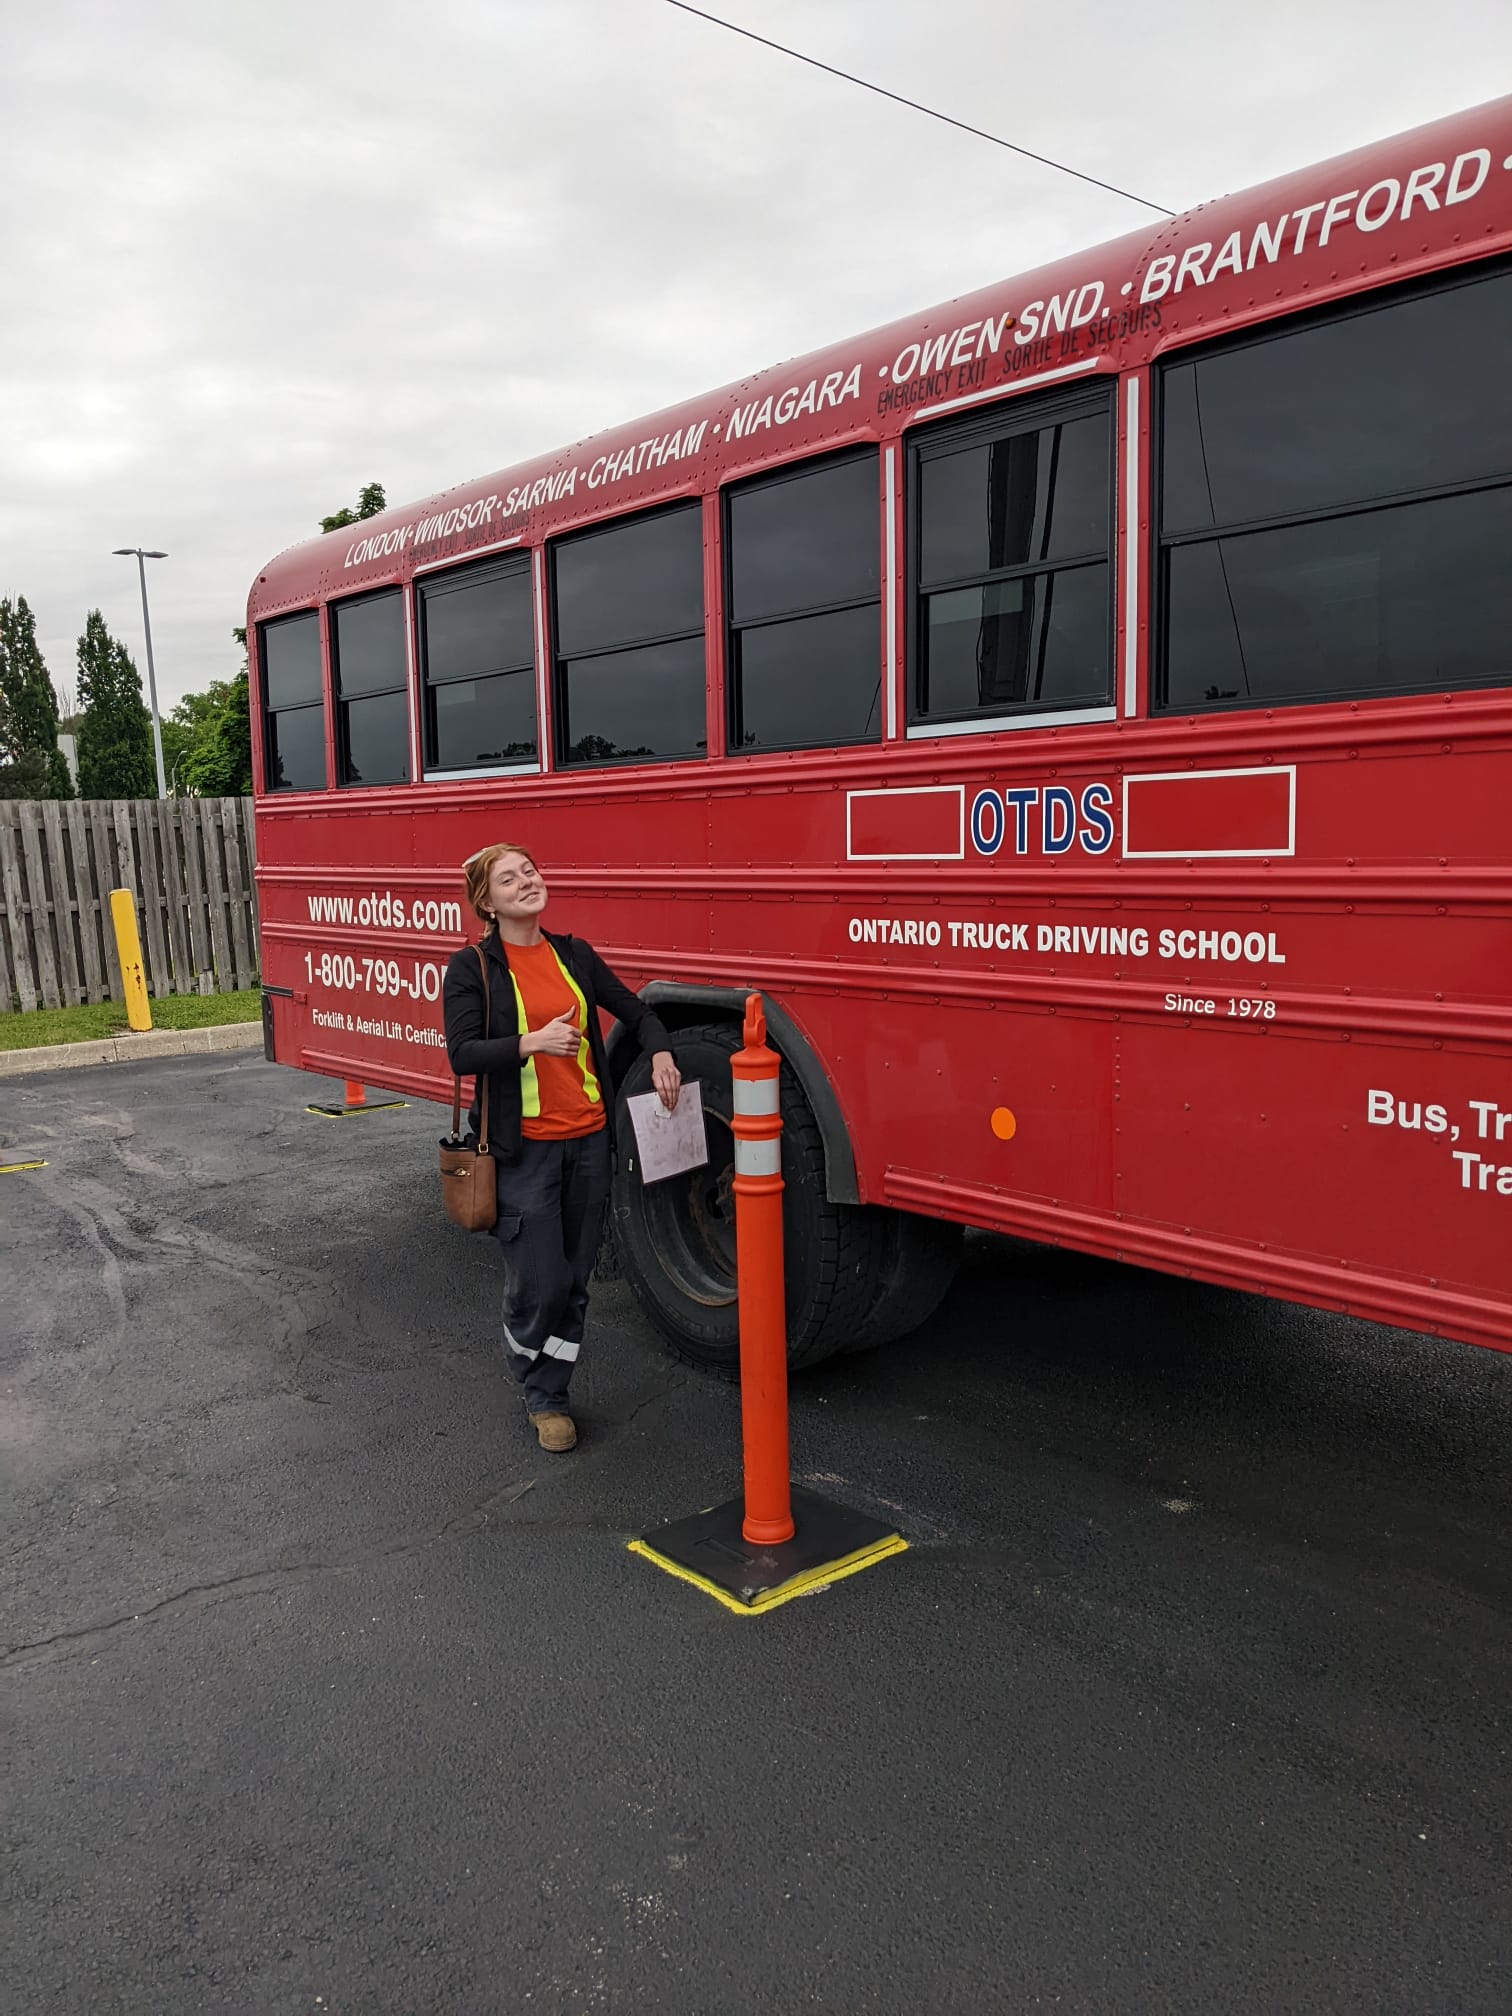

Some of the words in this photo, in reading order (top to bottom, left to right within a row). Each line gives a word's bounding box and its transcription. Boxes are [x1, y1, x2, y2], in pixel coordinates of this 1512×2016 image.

[344, 524, 410, 568] LONDON
[414, 495, 498, 546] WINDSOR
[502, 470, 577, 518] SARNIA
[586, 419, 709, 488] CHATHAM
[725, 364, 862, 442] NIAGARA
[891, 311, 1010, 384] OWEN
[1014, 281, 1110, 345] SND.
[1139, 148, 1491, 304] BRANTFORD
[877, 369, 953, 414] EMERGENCY
[958, 358, 988, 389] EXIT
[1002, 336, 1052, 375] SORTIE
[1060, 328, 1079, 358] DE
[970, 783, 1114, 856] OTDS
[307, 891, 462, 932] www.otds.com
[849, 918, 941, 946] ONTARIO
[948, 921, 1029, 951] TRUCK
[1037, 924, 1149, 956] DRIVING
[1158, 928, 1286, 964] SCHOOL
[304, 952, 449, 1001] 1-800-799-JO
[312, 1008, 344, 1030] Forklift
[347, 1014, 354, 1031] &
[356, 1017, 384, 1037] Aerial
[386, 1022, 403, 1041] Lift
[1164, 993, 1216, 1015] Since
[1227, 998, 1277, 1019] 1978
[1368, 1089, 1460, 1142] Bus,
